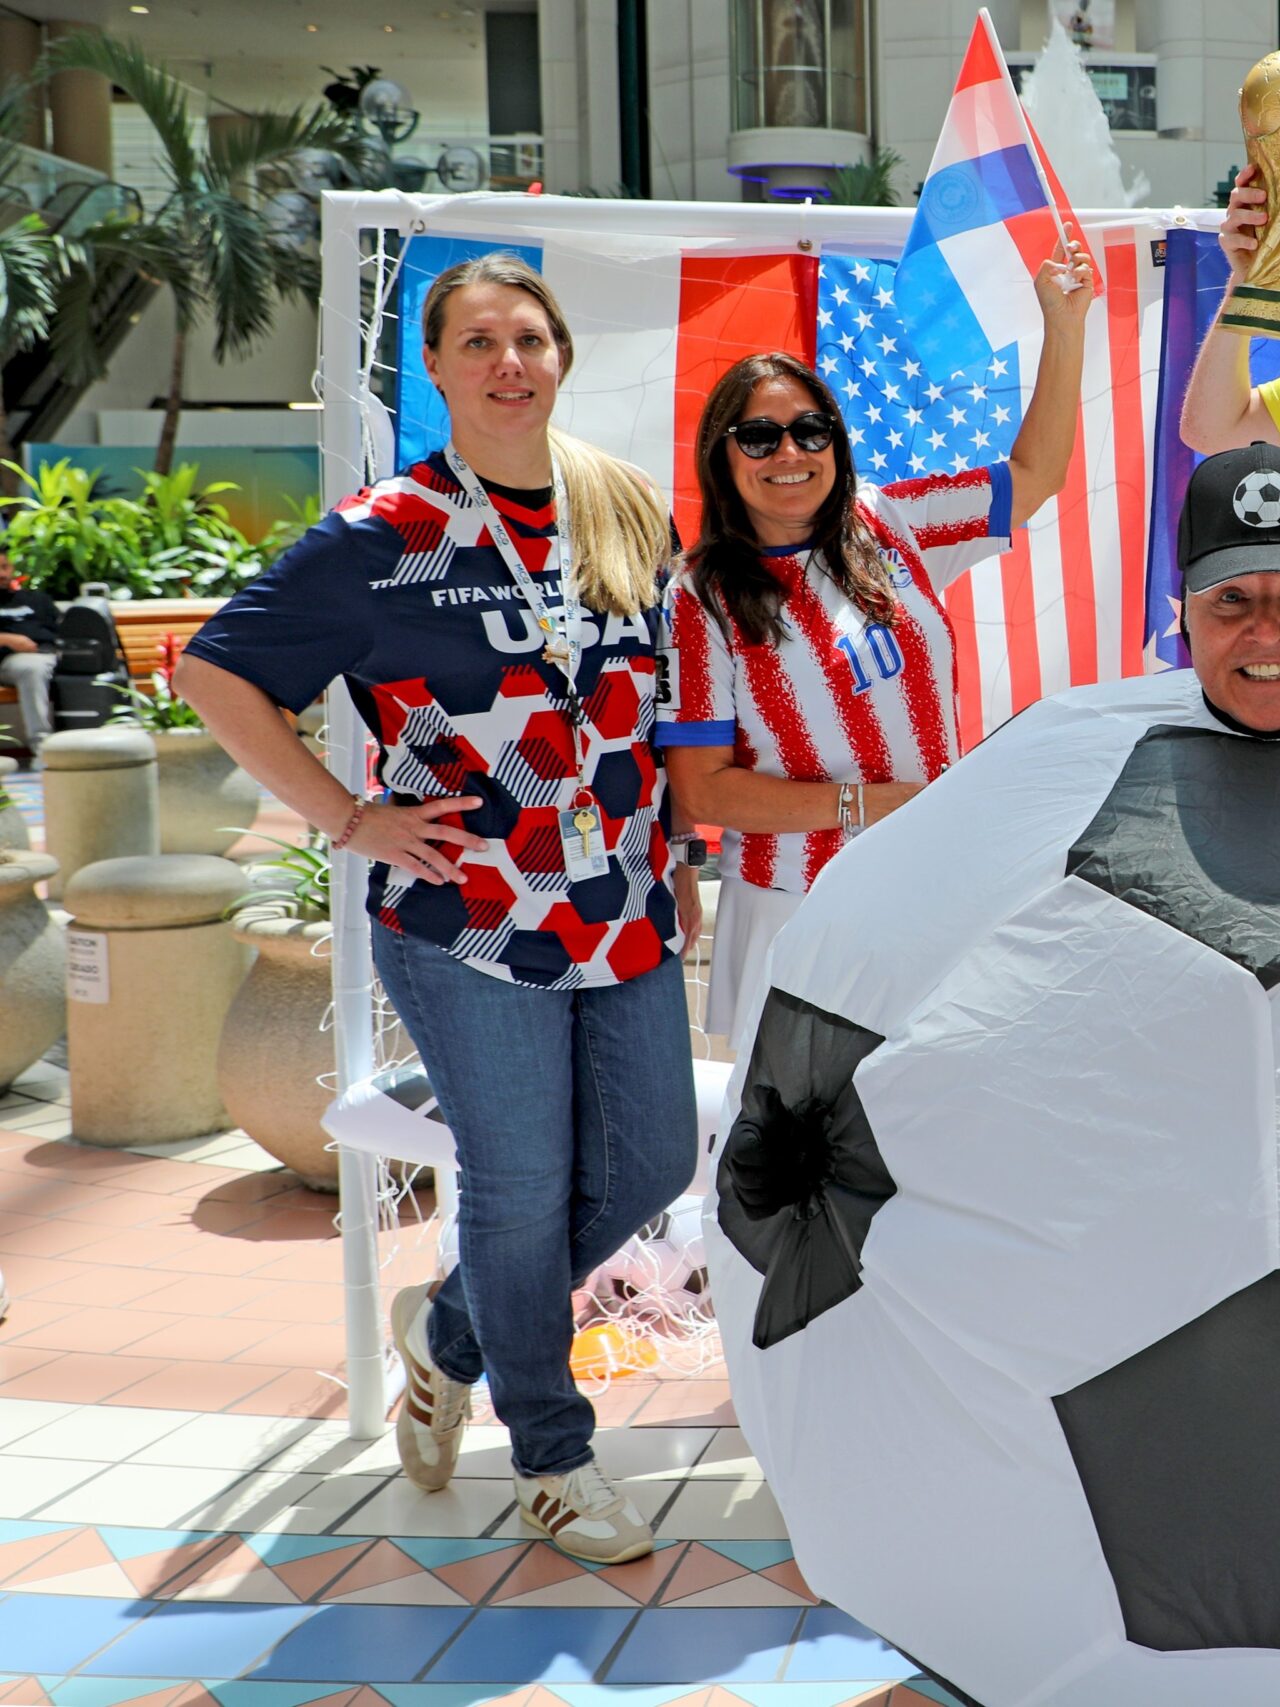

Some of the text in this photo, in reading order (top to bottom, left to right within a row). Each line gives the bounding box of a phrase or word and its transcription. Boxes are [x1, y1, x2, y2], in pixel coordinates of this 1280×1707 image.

[473, 486, 489, 507] MCO
[493, 524, 509, 546] MCO
[514, 563, 530, 585] MCO
[562, 558, 570, 579] MCO
[431, 585, 490, 607] FIFA
[565, 599, 575, 620] MCO
[480, 605, 652, 654] USA
[569, 640, 577, 662] MCO
[835, 622, 905, 696] 10
